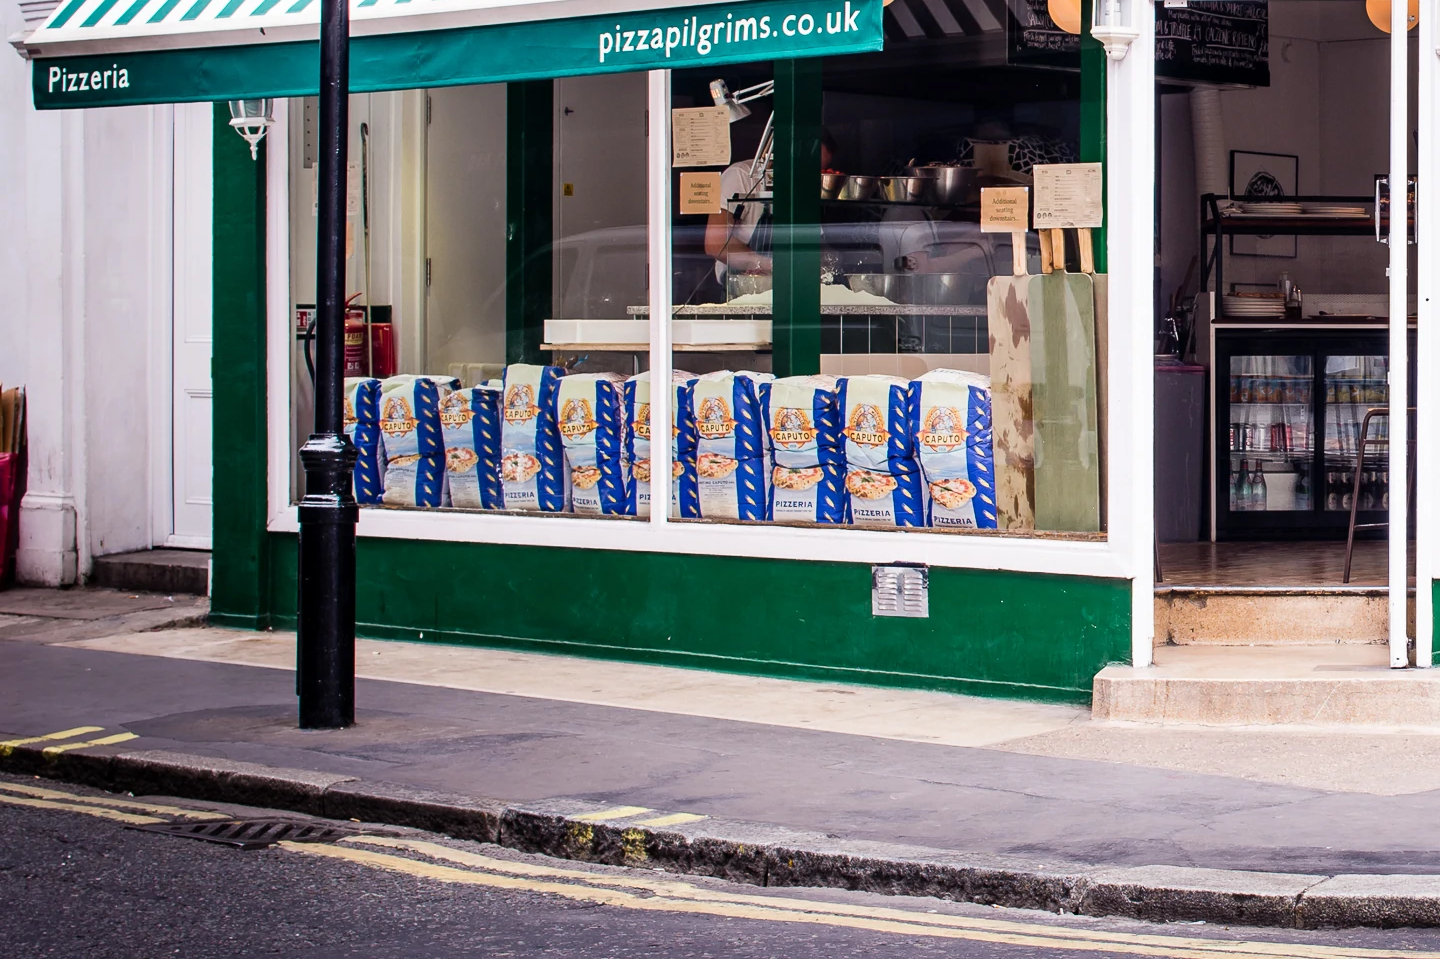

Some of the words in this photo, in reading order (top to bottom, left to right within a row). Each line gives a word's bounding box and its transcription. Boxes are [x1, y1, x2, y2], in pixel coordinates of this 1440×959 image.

[599, 1, 860, 63] pizzapilgrims.co.uk
[48, 64, 130, 93] Pizzeria
[441, 413, 468, 422] CAPUTO
[505, 409, 532, 418] CAPUTO
[384, 422, 411, 430] CAPUTO
[562, 424, 592, 433] CAPUTO
[700, 423, 730, 433] CAPUTO
[775, 432, 810, 441] CAPUTO
[850, 432, 883, 443] CAPUTO
[924, 434, 960, 444] CAPUTO
[504, 491, 535, 499] PIZZERIA
[775, 500, 813, 508] PIZZERIA
[854, 508, 891, 517] PIZZERIA
[933, 515, 973, 525] PIZZERIA
